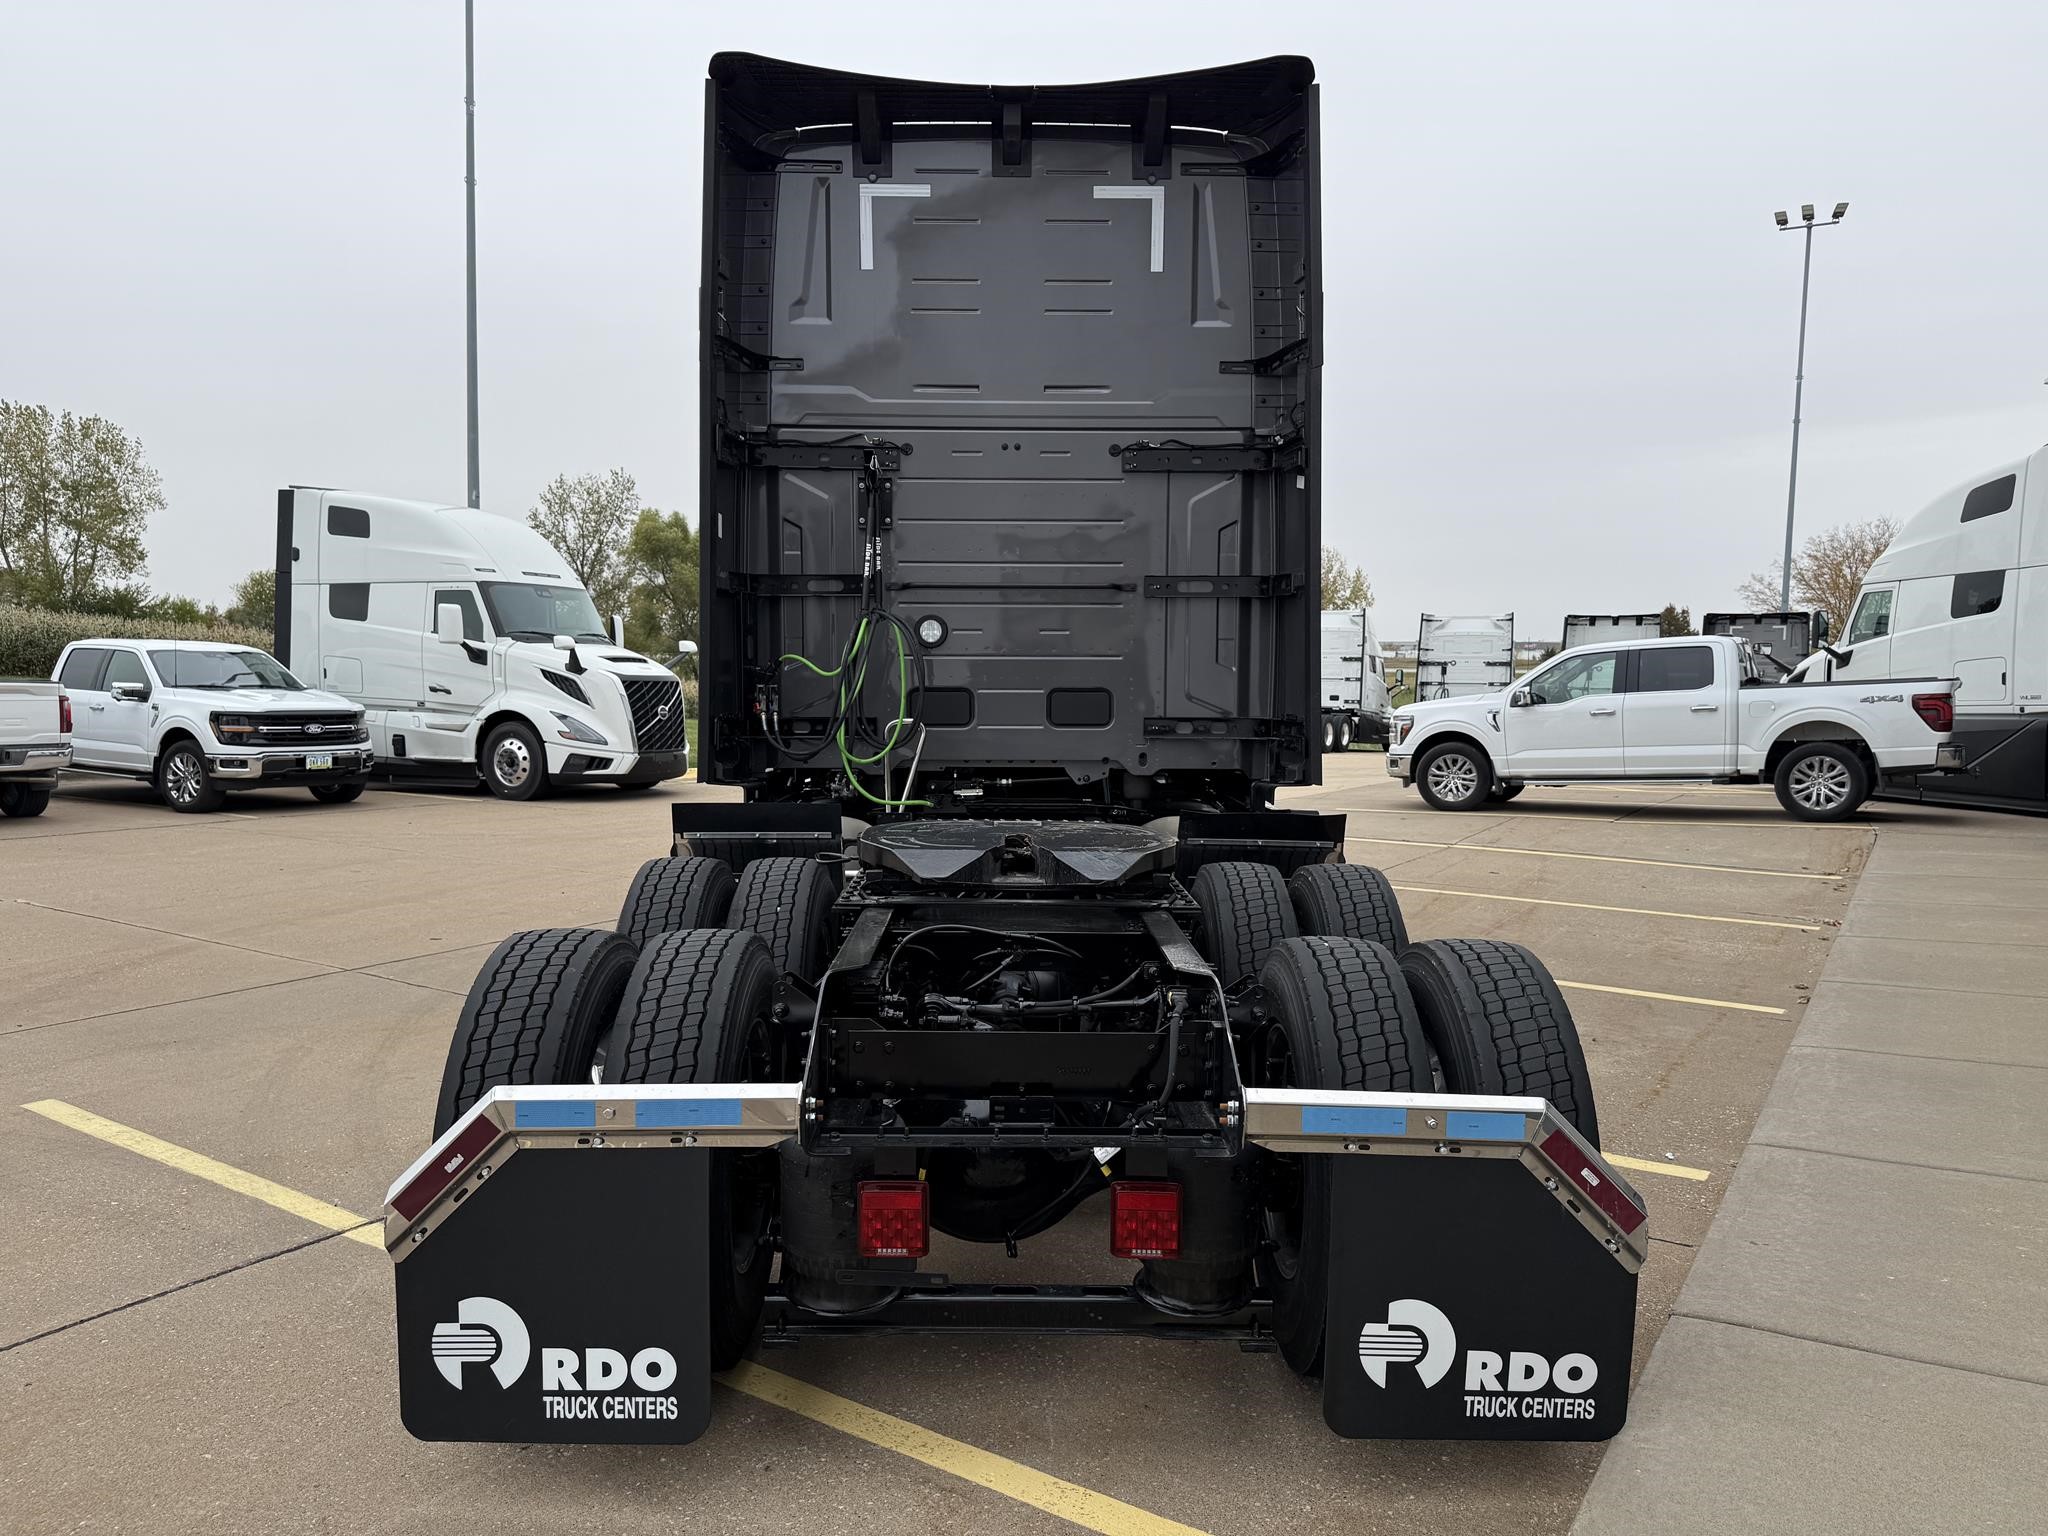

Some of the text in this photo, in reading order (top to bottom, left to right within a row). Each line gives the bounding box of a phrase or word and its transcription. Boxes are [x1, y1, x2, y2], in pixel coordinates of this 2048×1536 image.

[542, 1347, 677, 1391] RDO
[1464, 1350, 1598, 1393] RDO
[542, 1396, 678, 1419] TRUCK CENTERS
[1464, 1396, 1595, 1419] TRUCK CENTERS
